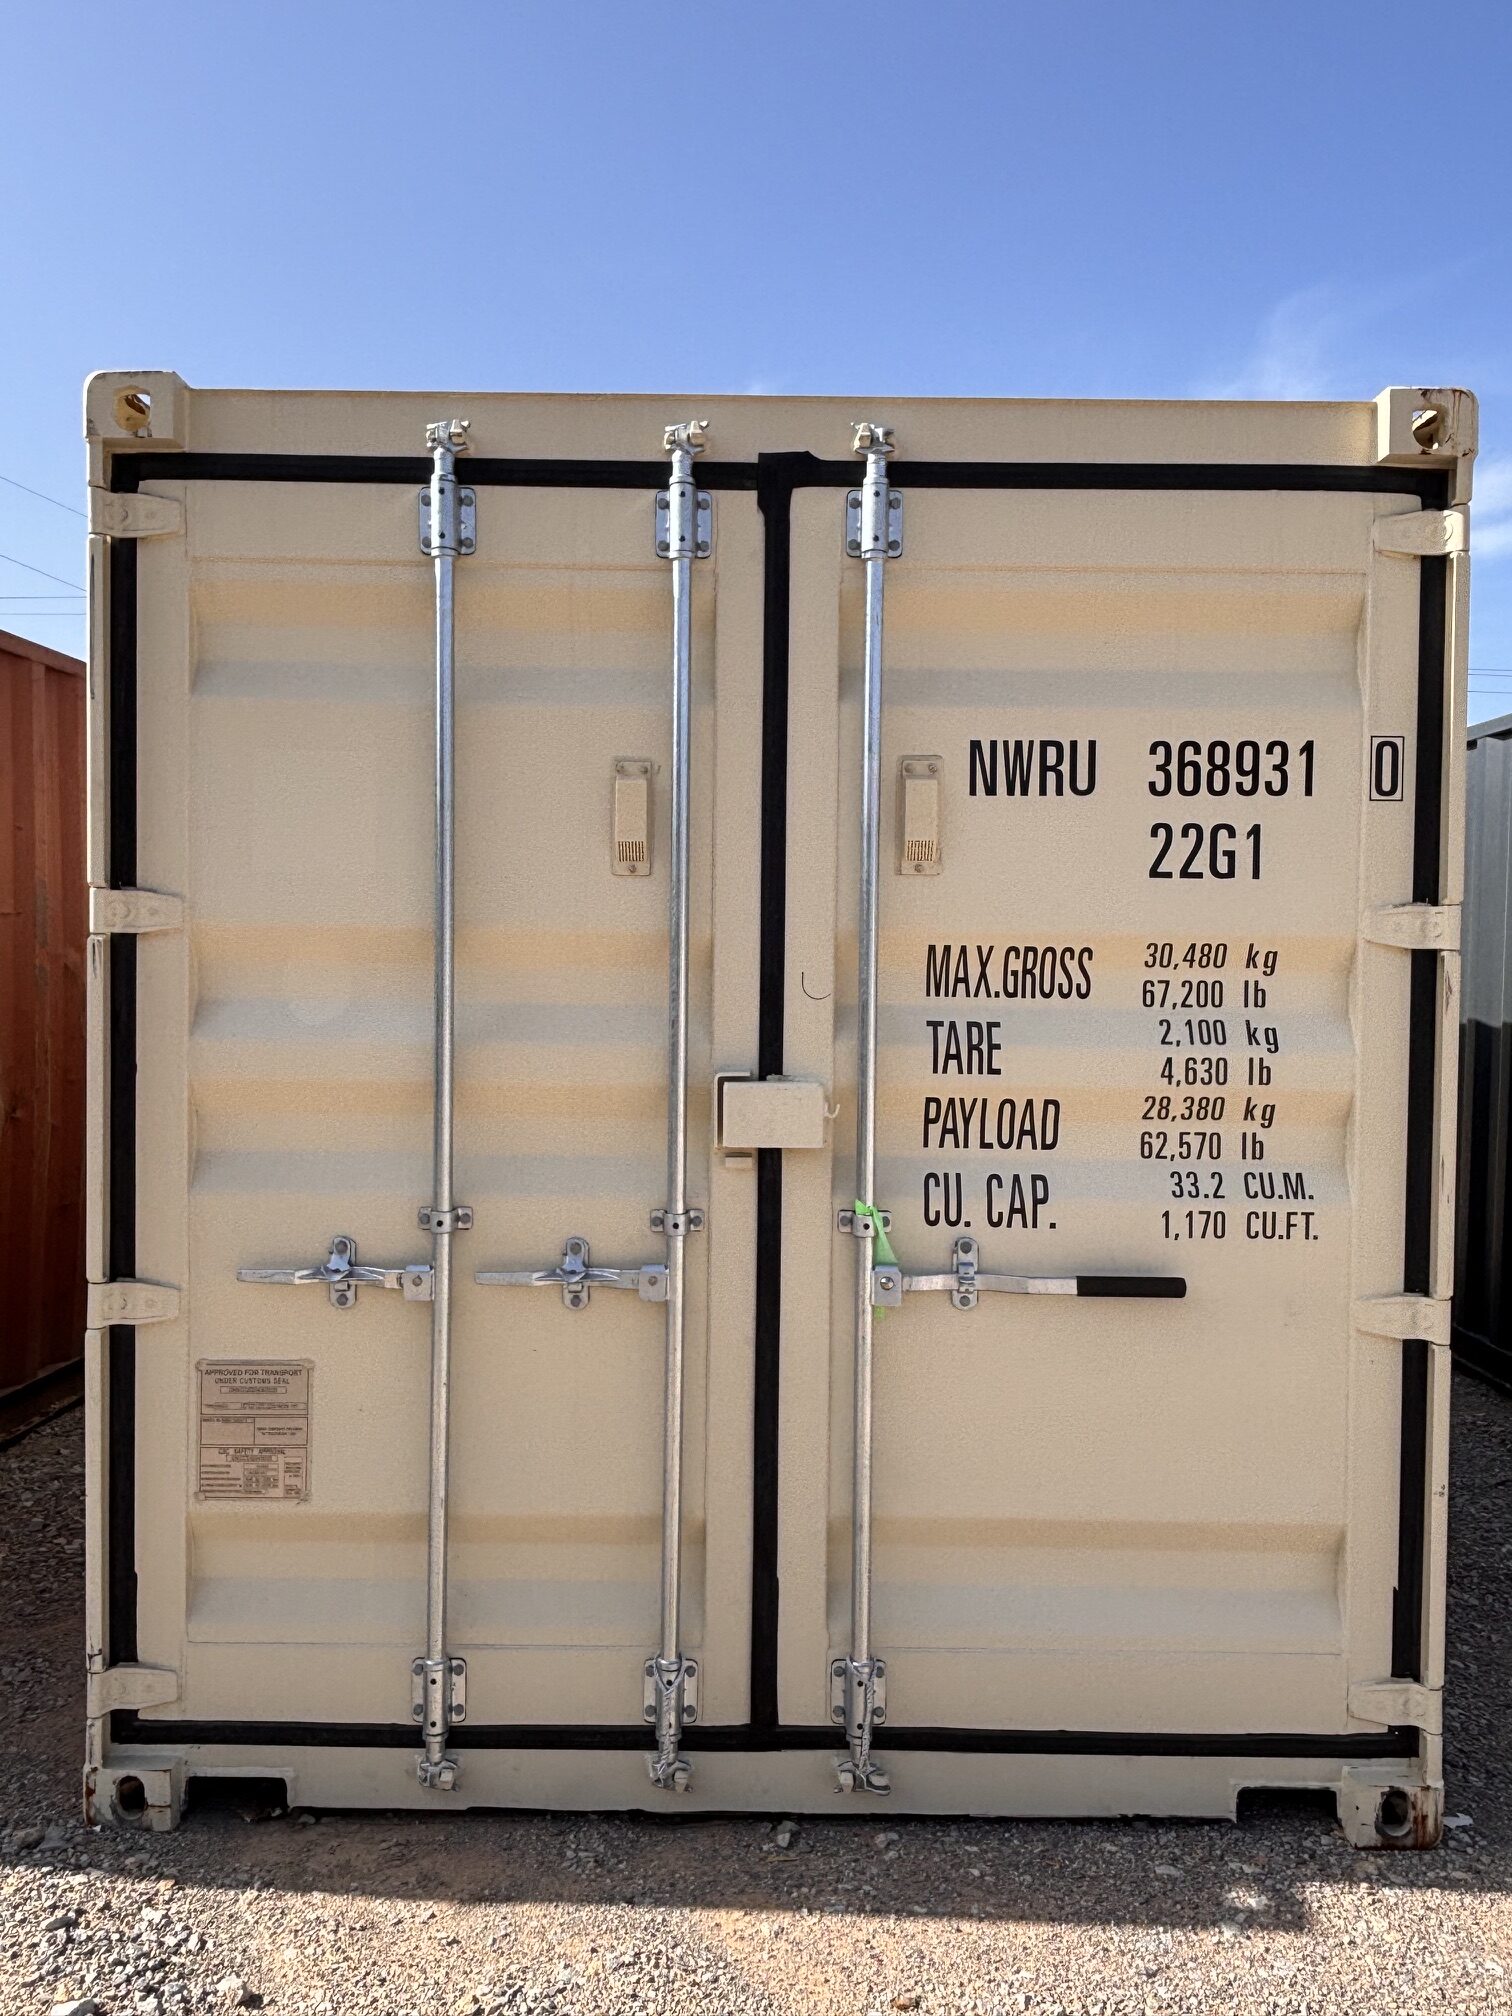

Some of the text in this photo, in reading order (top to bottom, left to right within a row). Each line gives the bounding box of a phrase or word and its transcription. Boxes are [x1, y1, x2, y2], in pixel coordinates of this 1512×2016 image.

[969, 739, 1400, 797] NWRU 368931 0
[1148, 822, 1261, 880] 22G1
[925, 944, 1094, 1000] MAX.GROSS
[1144, 942, 1279, 977] 30,480 kg
[1142, 979, 1267, 1010] 67,200 lb
[925, 1020, 1002, 1076] TARE
[1158, 1018, 1280, 1054] 2,100 kg
[1160, 1056, 1272, 1088] 4,630 lb
[922, 1096, 1061, 1151] PAYLOAD
[1141, 1095, 1276, 1129] 28,380 kg
[1140, 1131, 1265, 1162] 62,570 lb
[923, 1172, 1057, 1230] CU. CAP.
[1169, 1170, 1314, 1200] 33.2 CU.M.
[1161, 1210, 1319, 1241] 1,170 CU.FT.
[204, 1368, 303, 1376] APPROVED FOR TRANSPORT
